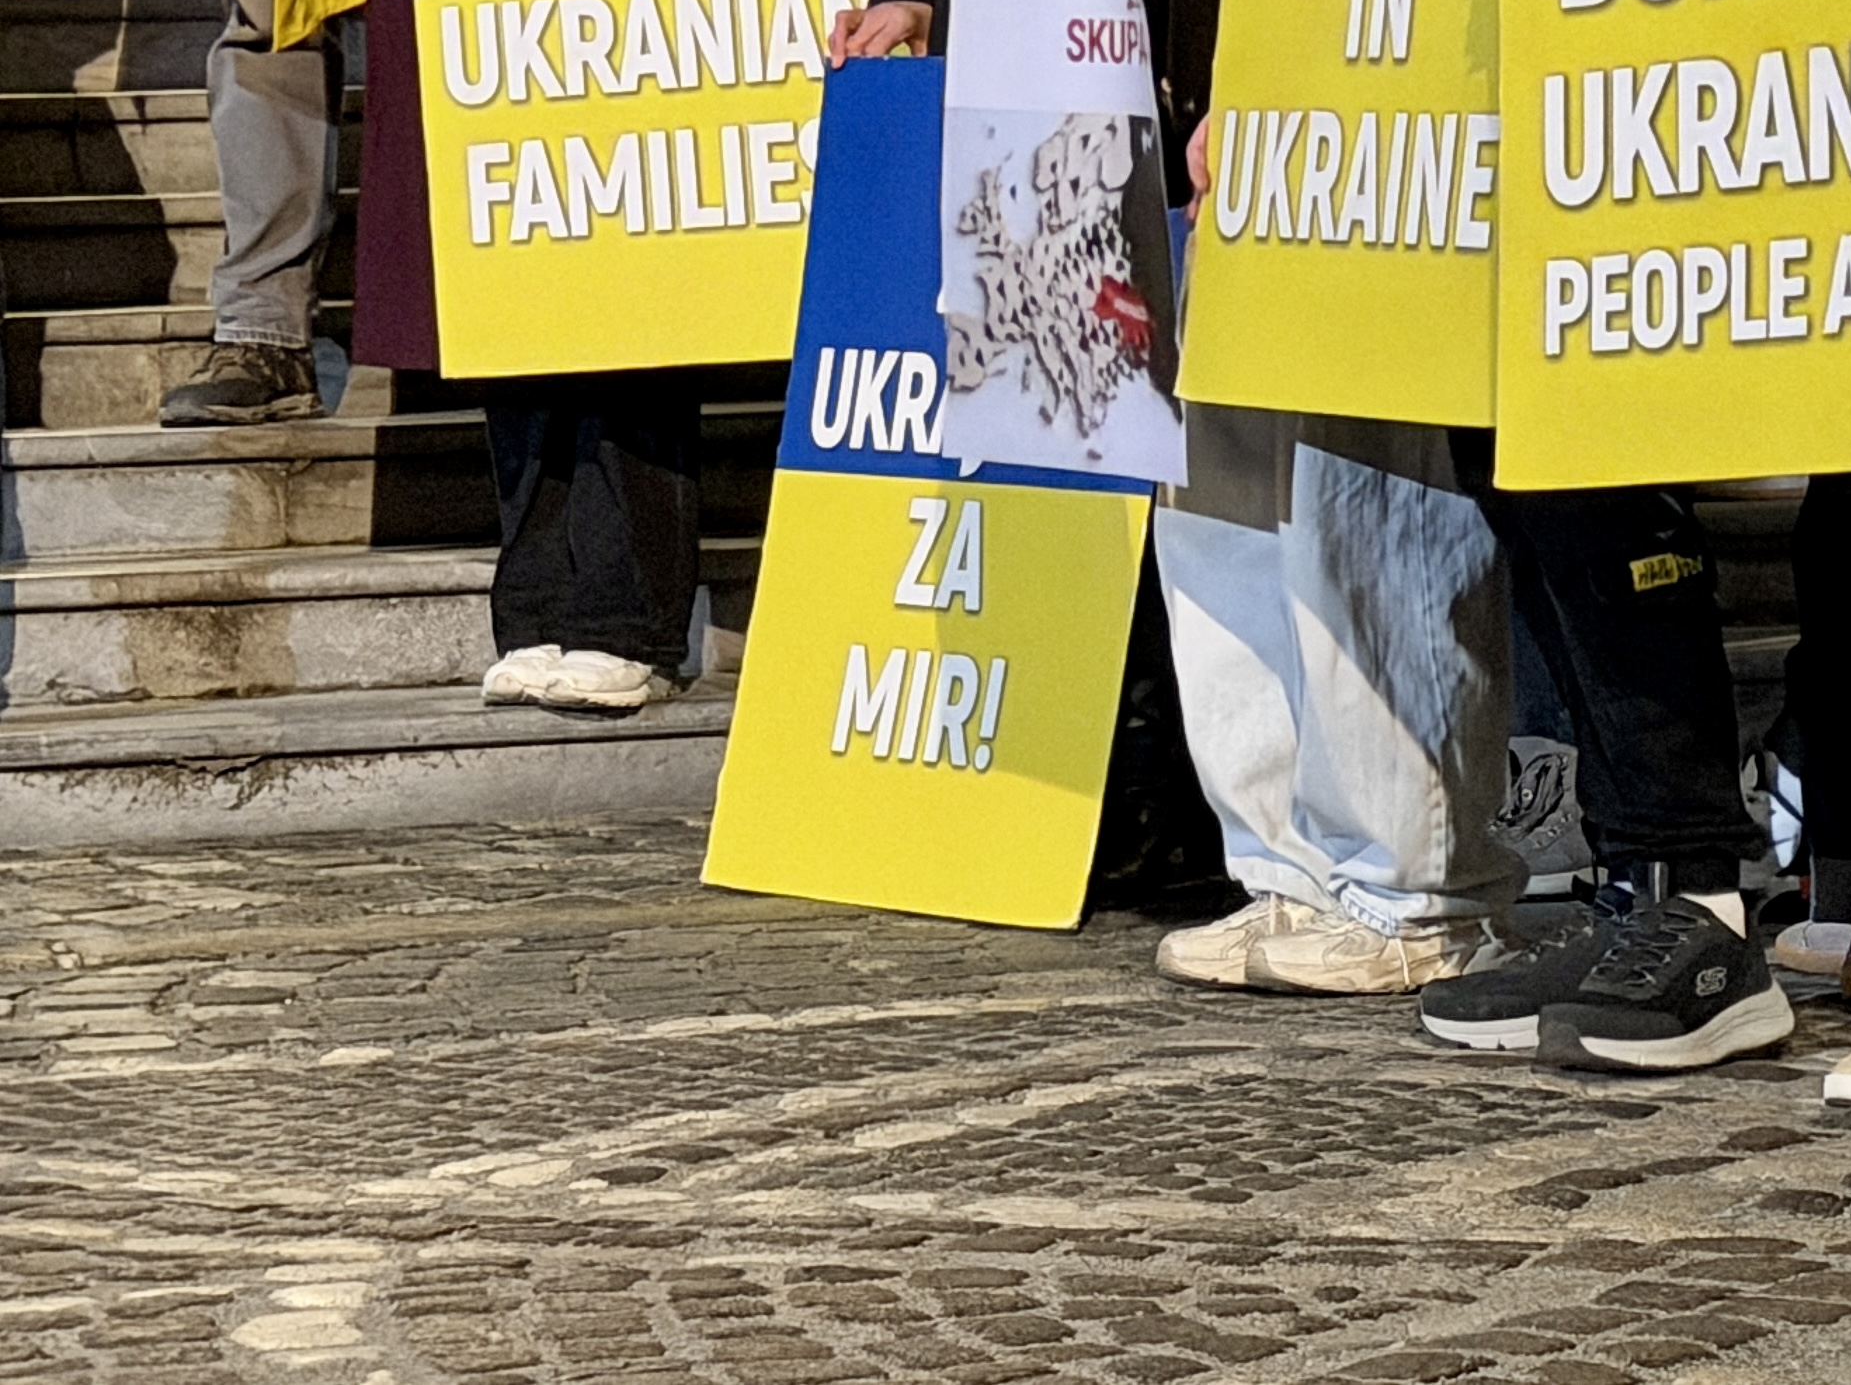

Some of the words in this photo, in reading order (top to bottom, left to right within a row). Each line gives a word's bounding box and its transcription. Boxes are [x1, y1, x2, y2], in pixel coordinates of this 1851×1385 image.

[1216, 111, 1499, 249] UKRAINE
[1545, 240, 1808, 356] PEOPLE
[894, 497, 982, 611] ZA
[831, 644, 1006, 770] MIR!
